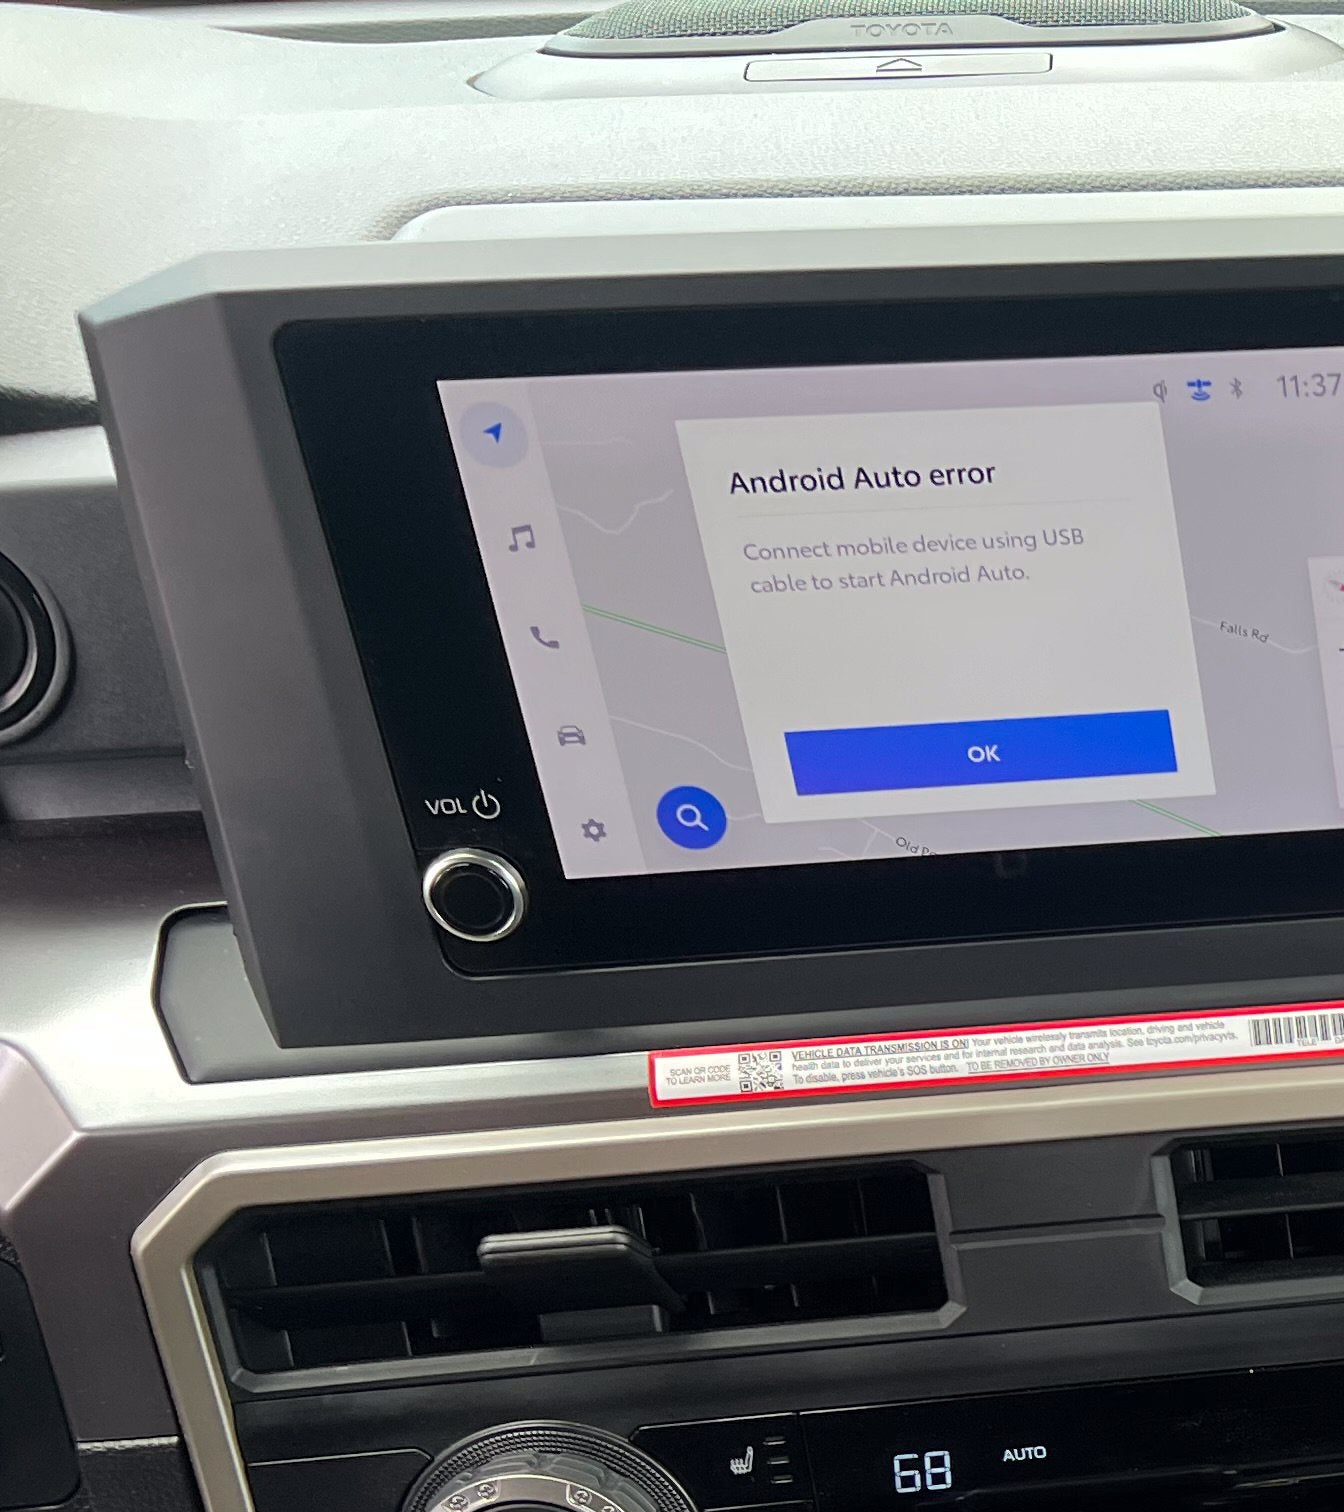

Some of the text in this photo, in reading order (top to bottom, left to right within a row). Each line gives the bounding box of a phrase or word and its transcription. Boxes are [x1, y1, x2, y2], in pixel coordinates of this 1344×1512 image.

[850, 22, 953, 37] TOYOTA
[1277, 373, 1342, 398] 11:37
[730, 465, 996, 495] Android Auto error
[744, 528, 1083, 561] Connect mobile device using USB
[751, 566, 1030, 594] cable to start Android Auto.
[1220, 621, 1269, 643] Falls Rd
[968, 745, 1000, 763] OK
[425, 797, 468, 815] VOL
[896, 837, 919, 855] Old
[792, 1048, 833, 1061] VEHICLE
[836, 1046, 862, 1057] DATA
[864, 1040, 938, 1055] TRANSMISSION
[941, 1039, 950, 1049] IS
[967, 1052, 1110, 1072] TO BE REMOVED BY OWNER ONLY
[893, 1446, 1047, 1493] 68 AUTO
